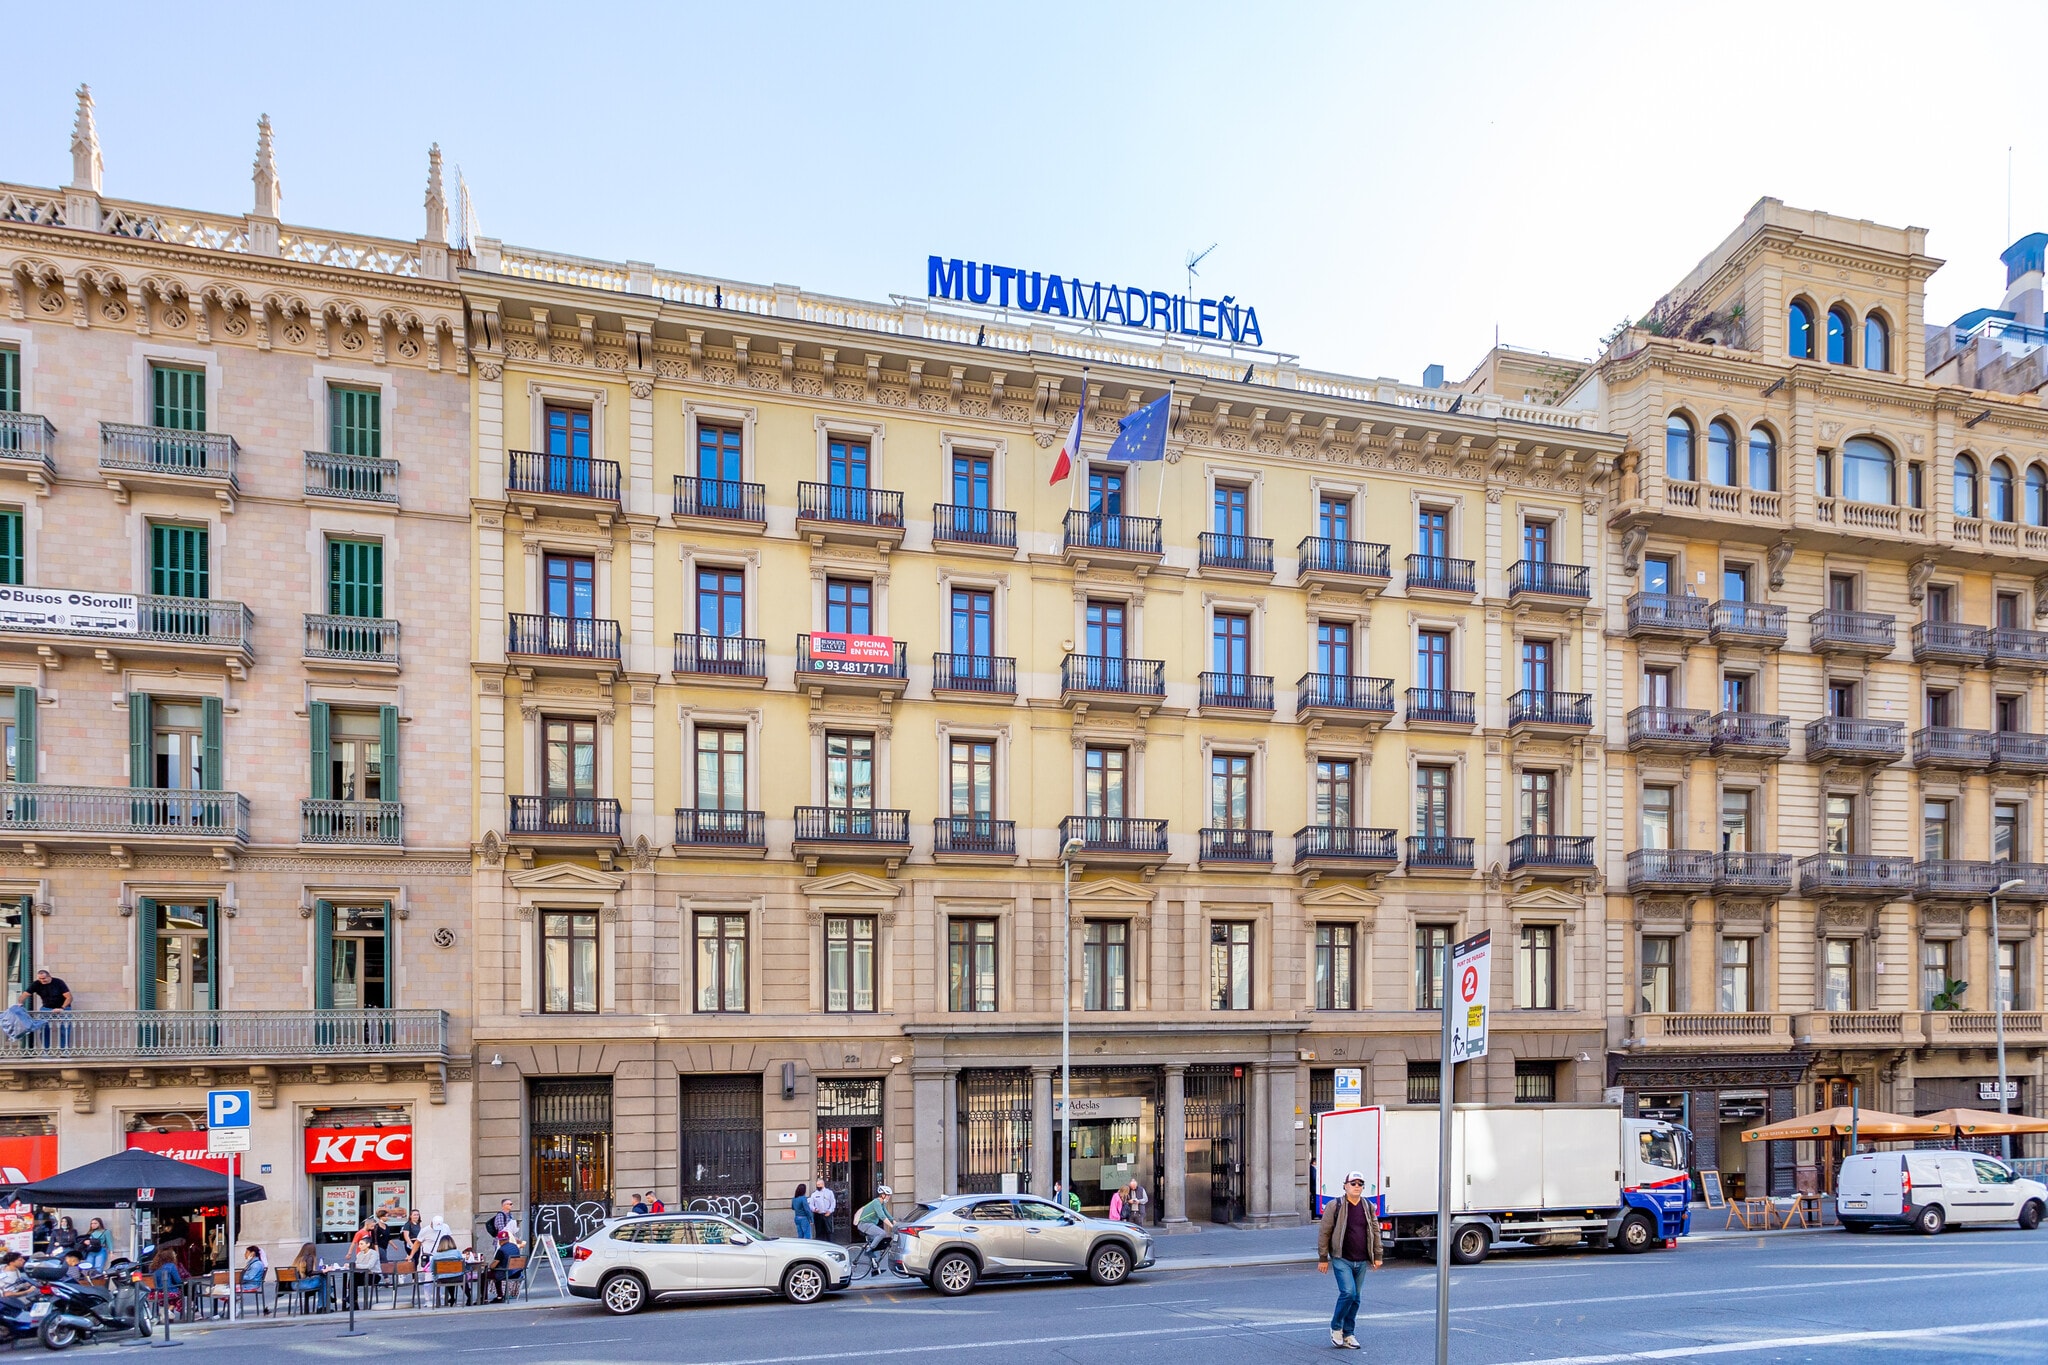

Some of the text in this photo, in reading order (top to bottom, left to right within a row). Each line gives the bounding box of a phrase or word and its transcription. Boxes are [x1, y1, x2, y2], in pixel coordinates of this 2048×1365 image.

[13, 590, 132, 609] Busos Soroll!
[863, 649, 889, 657] VENTA
[826, 660, 889, 674] 93 481 71 71
[1464, 972, 1475, 996] 2
[1338, 1077, 1346, 1087] P
[1980, 1082, 1993, 1092] THE
[214, 1094, 241, 1124] P
[1069, 1100, 1100, 1109] Adeslas
[311, 1133, 407, 1163] KFC
